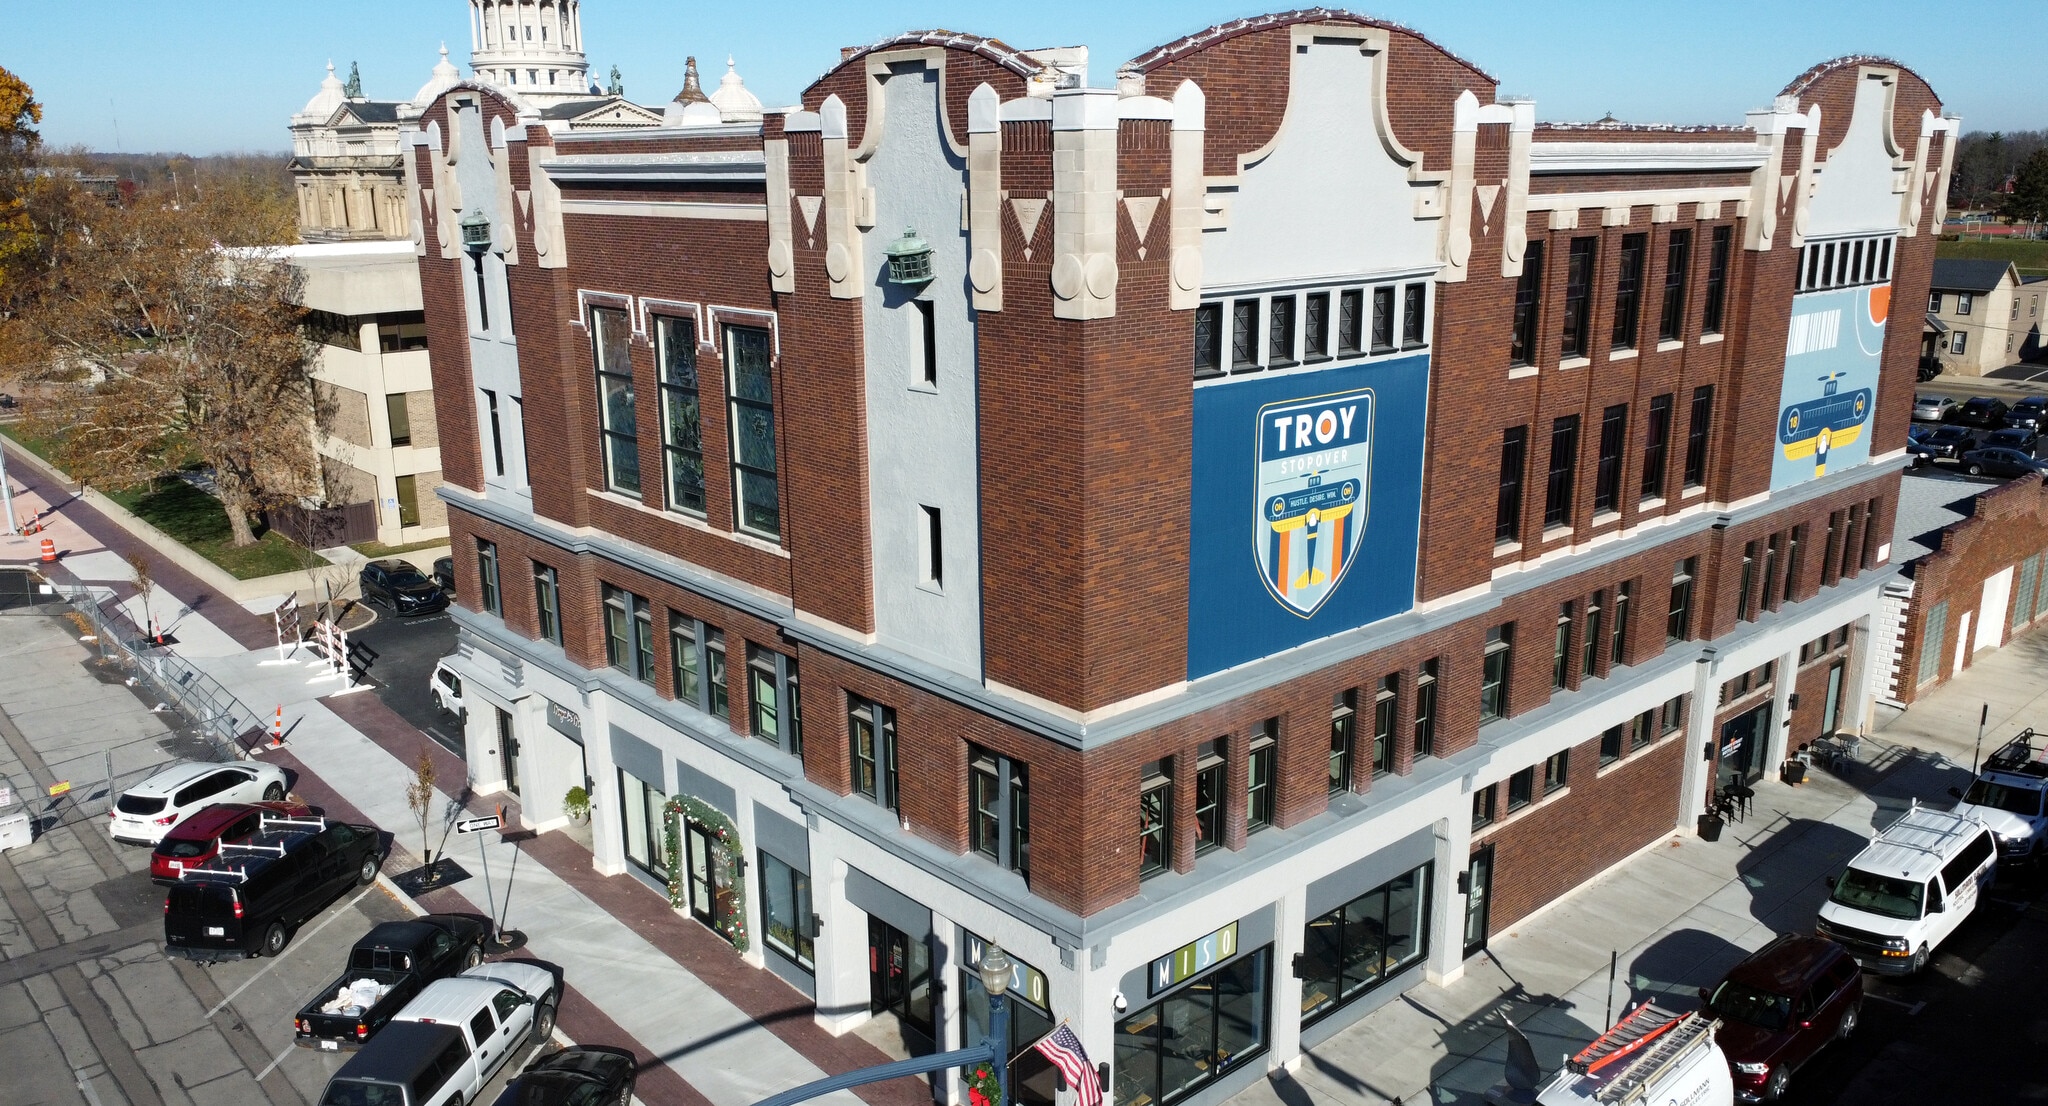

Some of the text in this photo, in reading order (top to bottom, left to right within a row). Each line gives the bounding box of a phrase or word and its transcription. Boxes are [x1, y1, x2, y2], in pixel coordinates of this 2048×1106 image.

[1856, 400, 1863, 411] 14
[1275, 405, 1357, 451] TROY
[1790, 416, 1798, 428] 18
[1281, 450, 1348, 474] STOPOVER
[1274, 503, 1283, 511] OH
[971, 938, 1042, 1001] MSO
[1159, 929, 1231, 988] MISO
